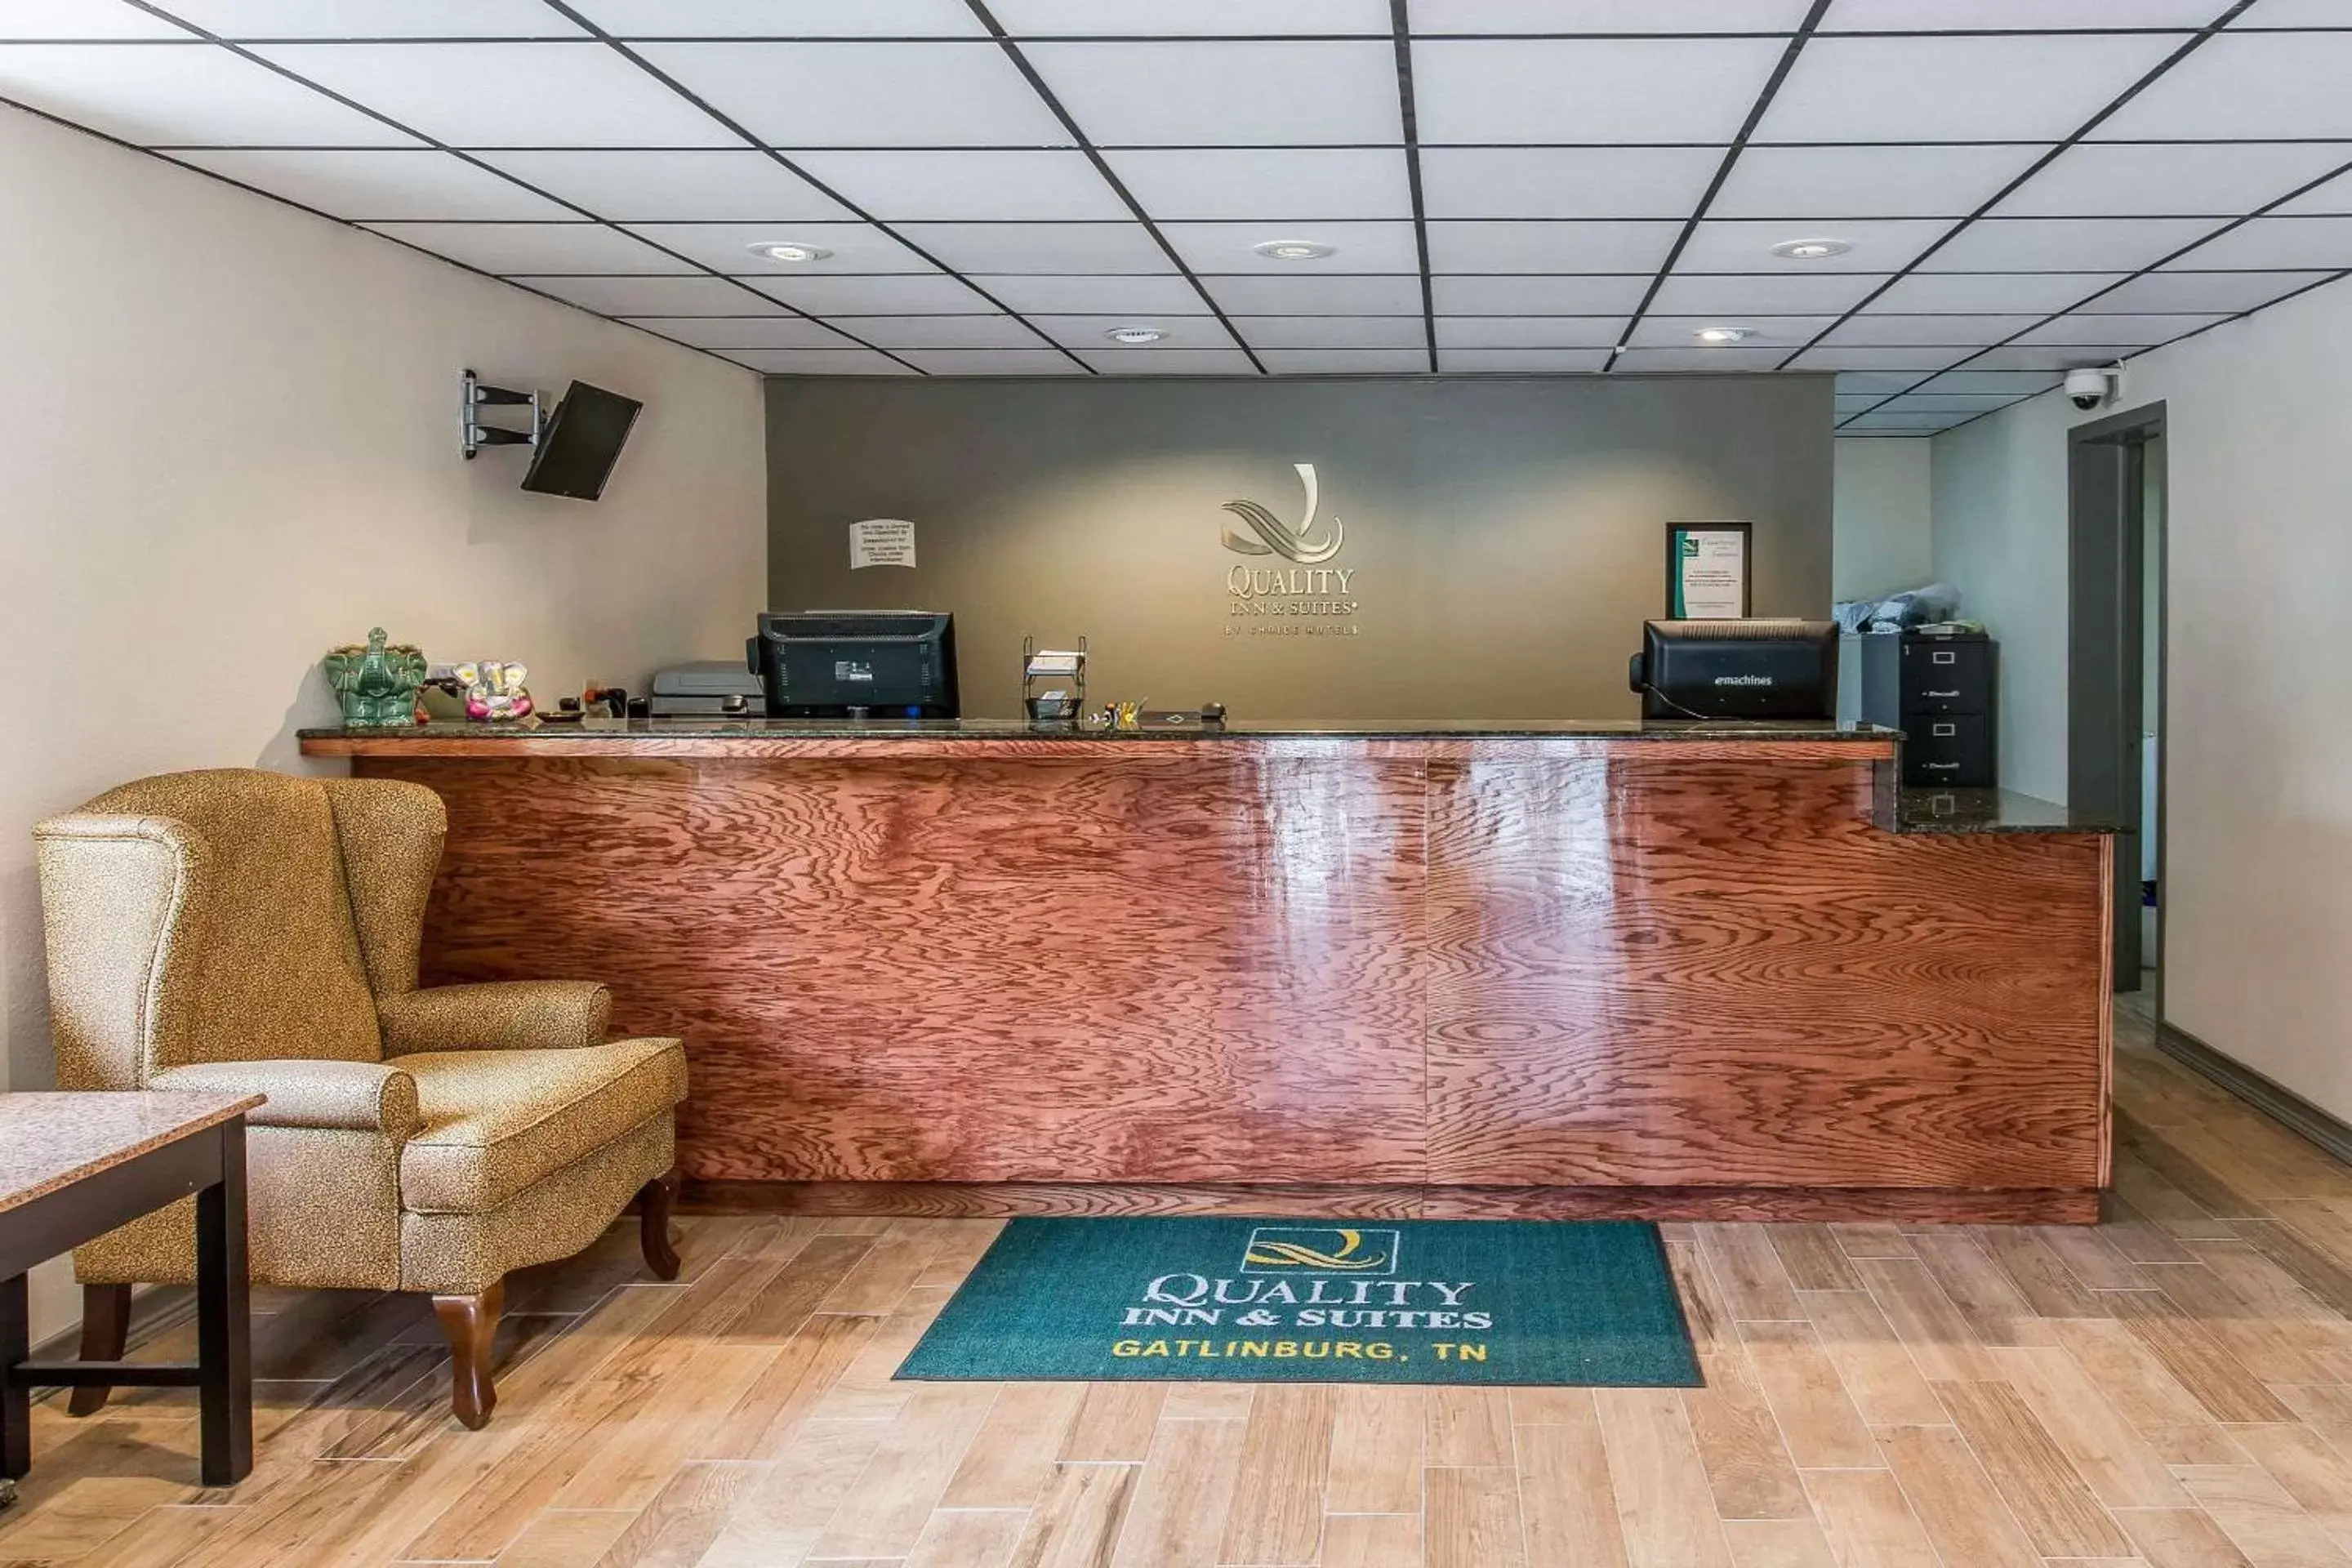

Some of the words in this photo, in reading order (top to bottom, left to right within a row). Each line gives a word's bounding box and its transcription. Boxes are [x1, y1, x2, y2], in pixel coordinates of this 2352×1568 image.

[1227, 565, 1354, 599] QUALITY
[1231, 602, 1266, 616] INN
[1272, 602, 1285, 615] &
[1715, 675, 1772, 686] emachines
[1143, 1273, 1474, 1307] QUALITY
[1120, 1307, 1223, 1326] INN
[1235, 1307, 1282, 1326] &
[1296, 1310, 1493, 1329] SUITES
[1433, 1343, 1488, 1362] TN
